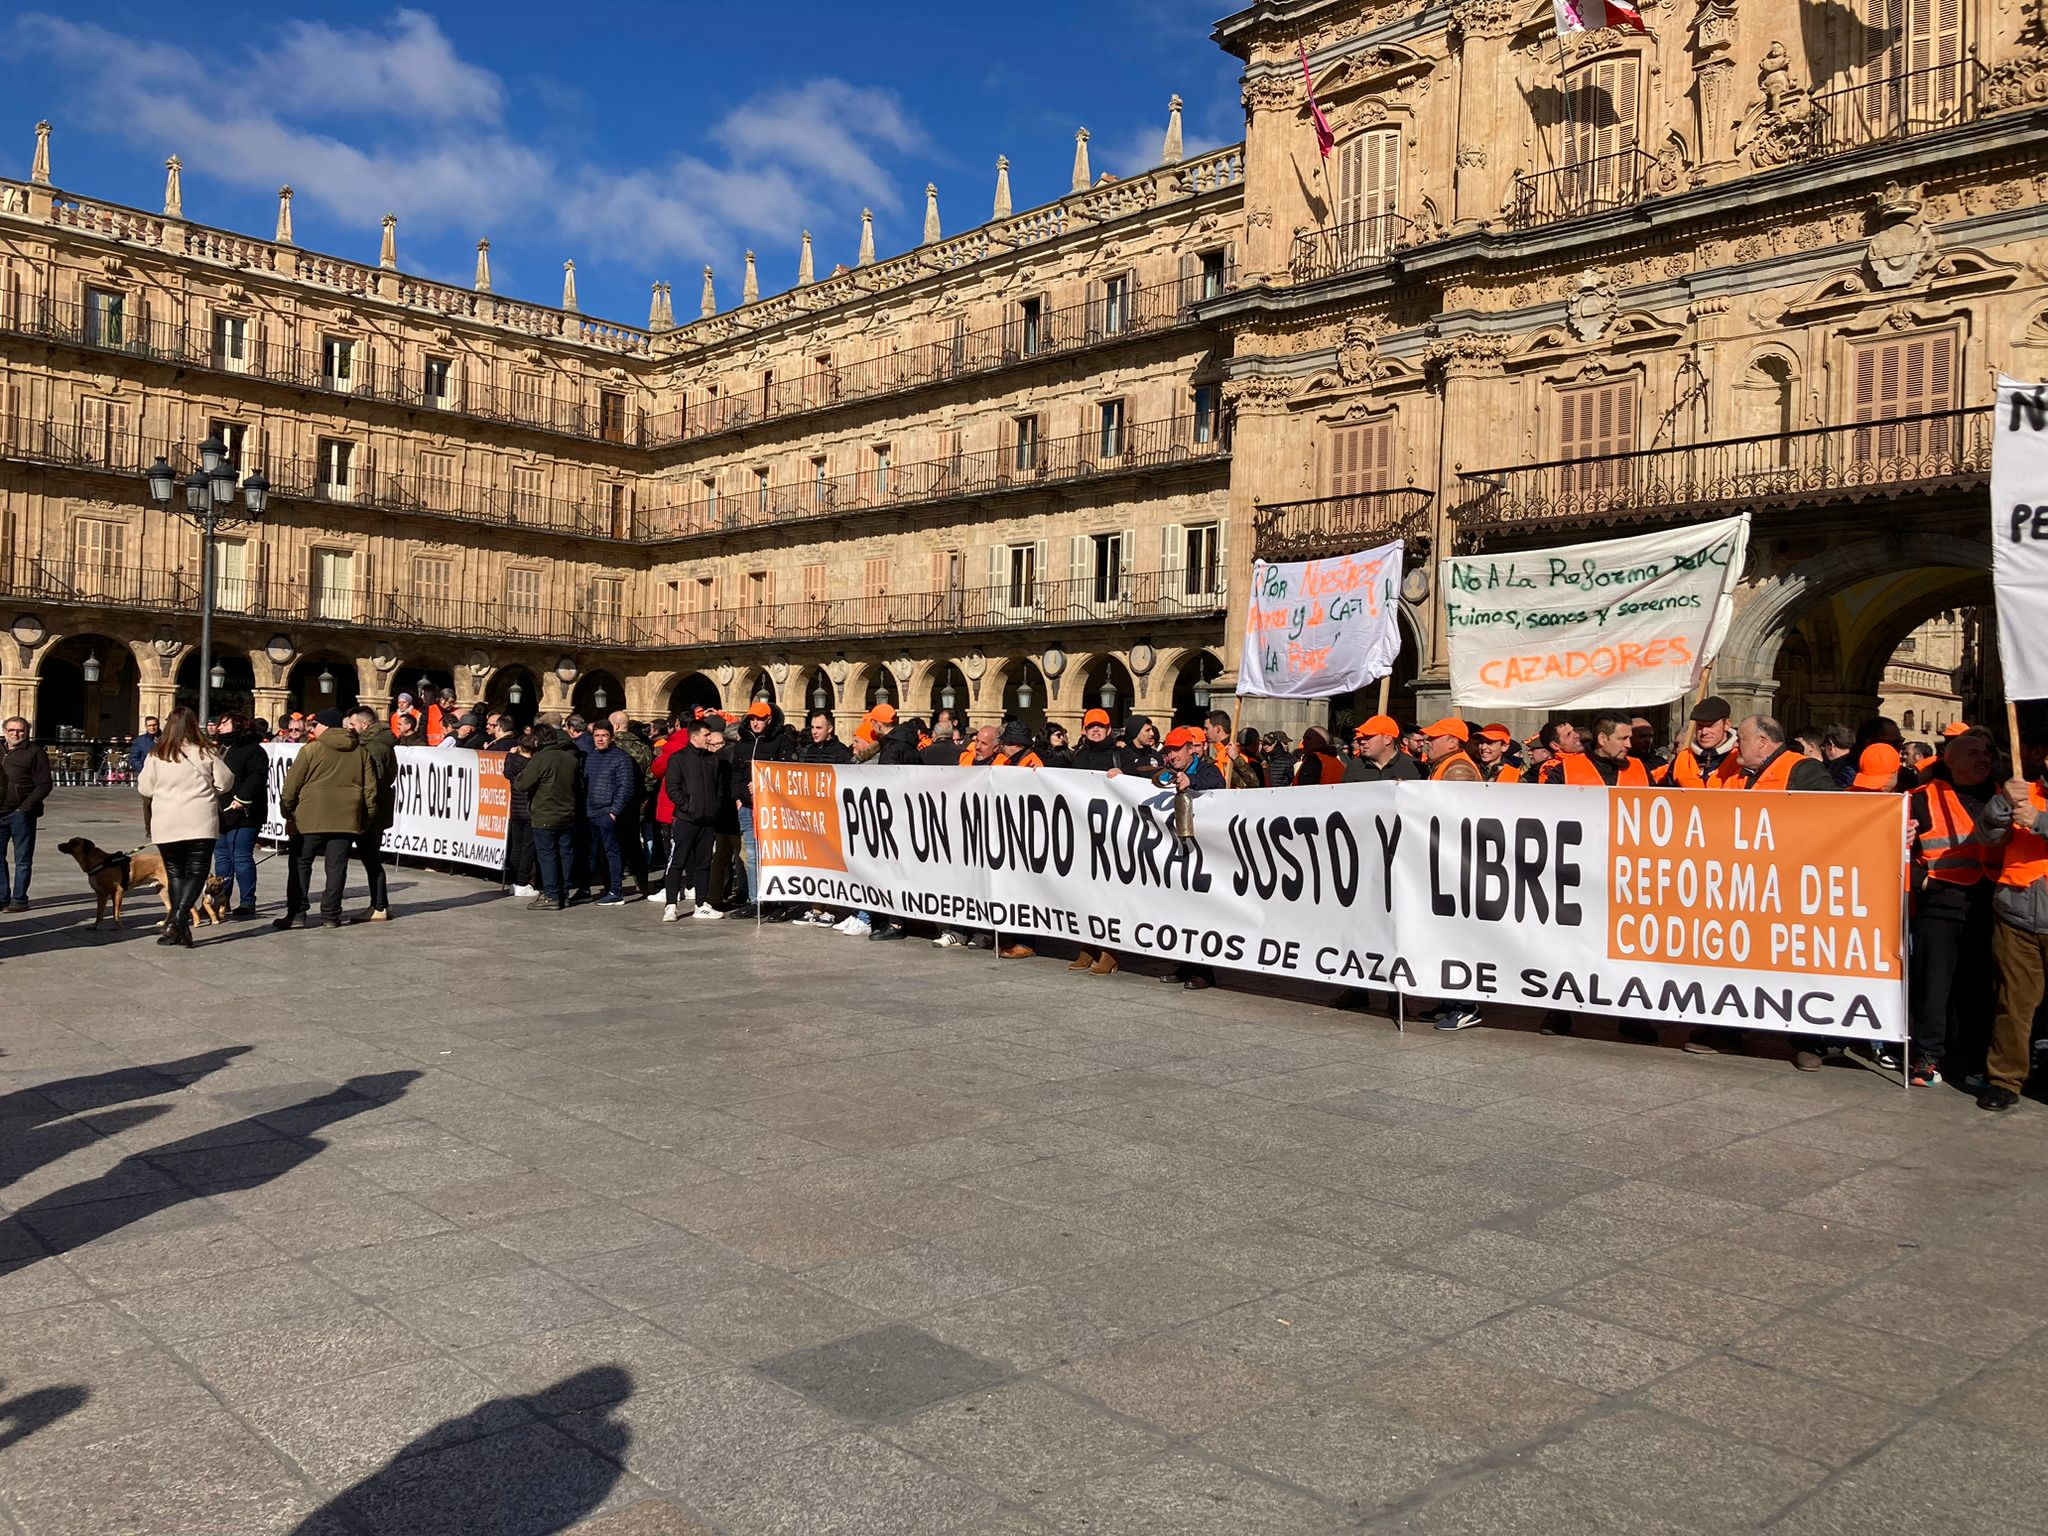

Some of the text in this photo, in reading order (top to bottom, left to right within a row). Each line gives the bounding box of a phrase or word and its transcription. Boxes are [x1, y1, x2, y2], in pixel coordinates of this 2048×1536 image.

[1488, 564, 1501, 589] A
[1525, 610, 1589, 629] somos
[1617, 593, 1702, 617] seremos
[1479, 636, 1693, 689] CAZADORES
[480, 758, 494, 775] ESTA
[787, 769, 810, 796] ESTA
[815, 771, 832, 798] LEY
[428, 762, 453, 819] QUE
[458, 767, 472, 821] TU
[480, 787, 507, 806] PROTEGE
[760, 806, 826, 835] DE BIENESTAR
[1616, 796, 1775, 851] NO A LA
[382, 832, 505, 865] DE CAZA DE SALAMANCA
[761, 838, 808, 861] ANIMAL
[843, 786, 1583, 927] POR UN MUNDO RURAL JUSTO Y LIBRE
[1615, 855, 1868, 918] REFORMA DEL
[766, 875, 1882, 1030] ASOCIACION INDEPENDIENTE DE COTOS DE CAZA DE SALAMANCA
[1616, 913, 1890, 972] CODIGO PENAL
